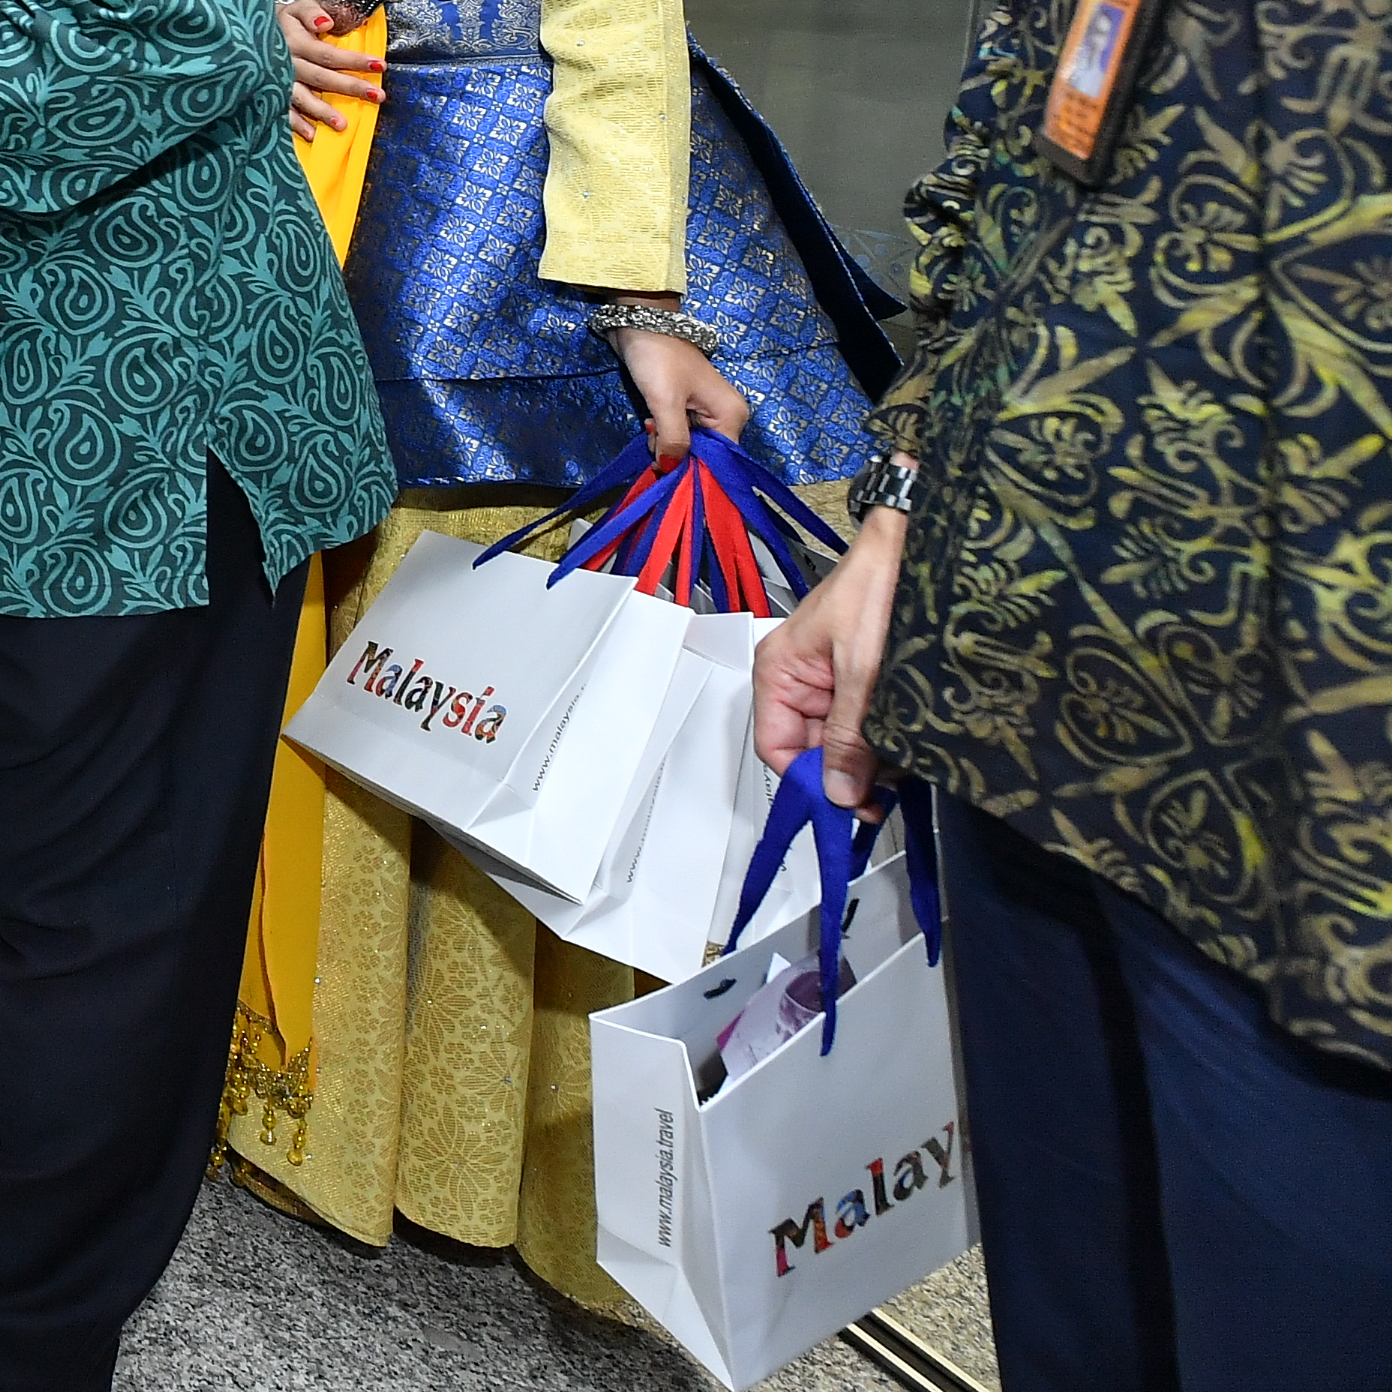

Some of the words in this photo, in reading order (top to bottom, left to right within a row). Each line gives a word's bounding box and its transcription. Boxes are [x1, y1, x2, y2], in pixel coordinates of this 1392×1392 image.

[346, 640, 507, 744] Malaysia
[654, 1107, 678, 1247] www.malaysia.travel
[768, 1121, 956, 1278] Malay
